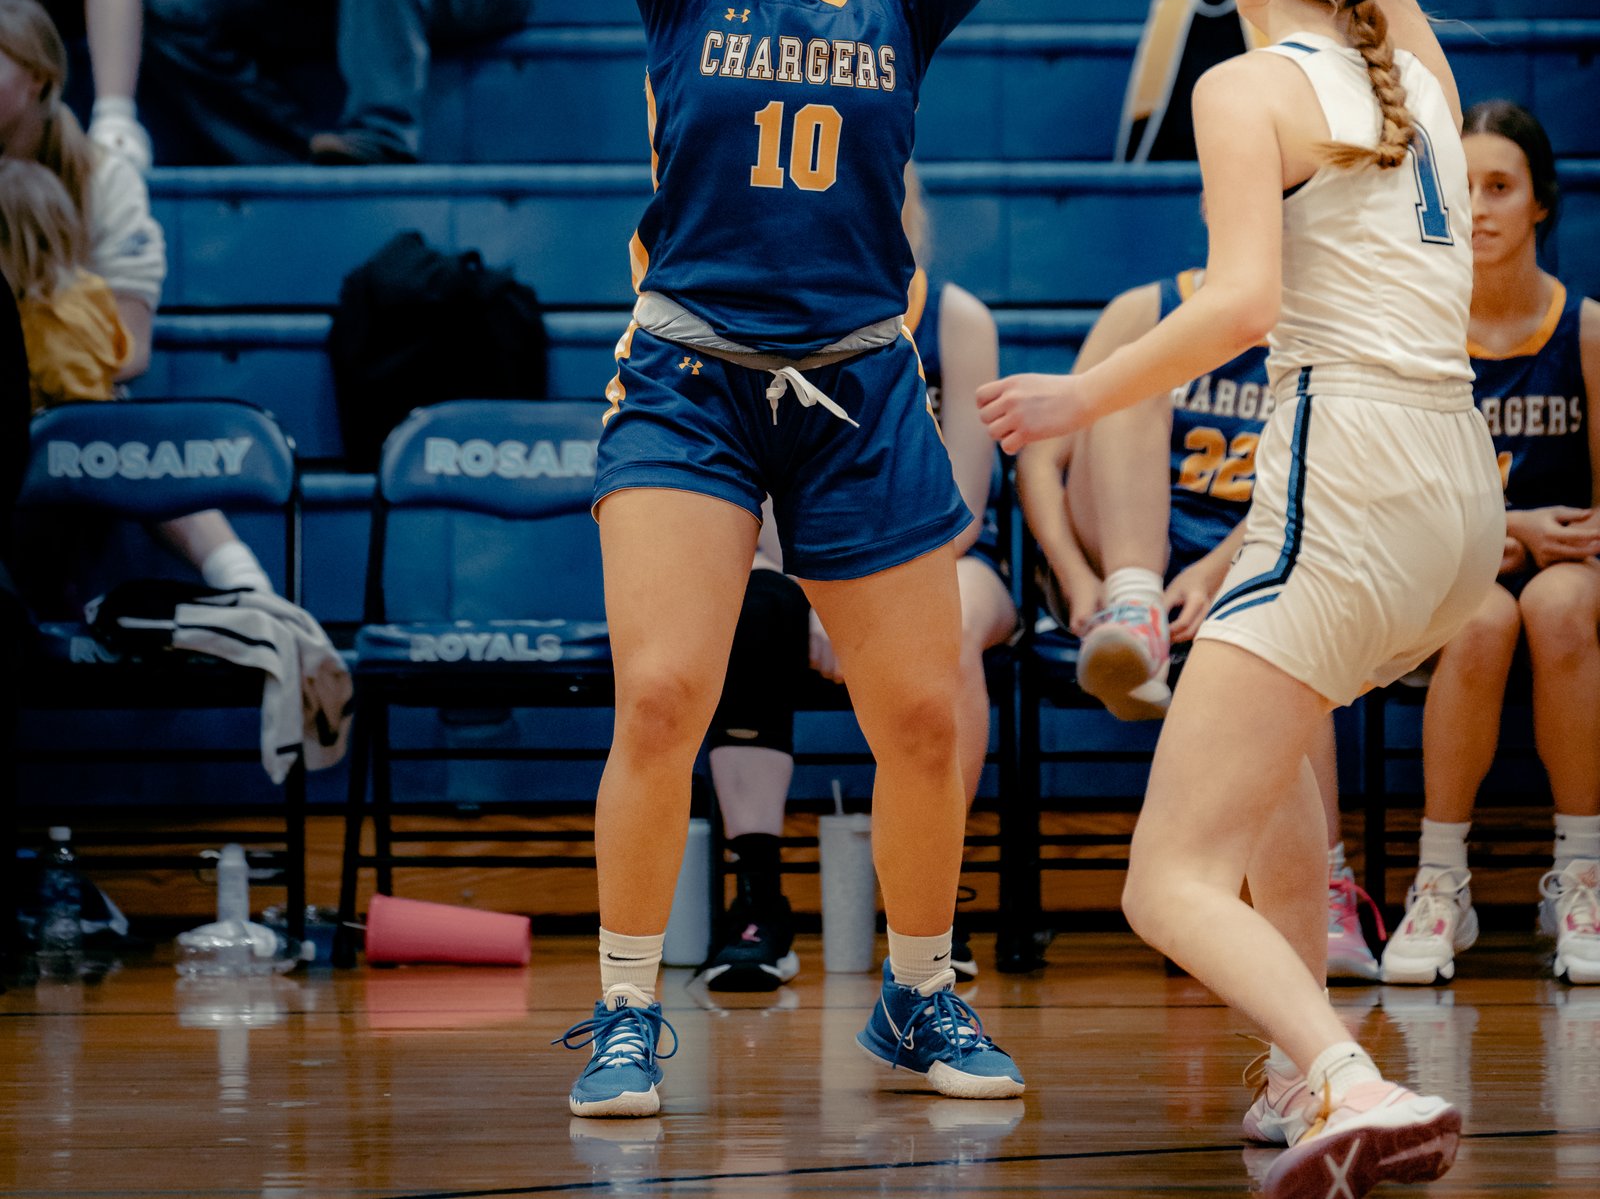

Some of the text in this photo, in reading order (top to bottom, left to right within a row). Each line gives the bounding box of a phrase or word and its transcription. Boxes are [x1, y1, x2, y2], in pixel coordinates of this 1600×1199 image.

[700, 30, 896, 92] CHARGERS
[749, 101, 843, 192] 10
[1406, 120, 1454, 246] 1
[47, 436, 254, 480] ROSARY
[424, 437, 600, 479] ROSAR
[1178, 426, 1262, 502] 22
[409, 633, 563, 663] ROYALS
